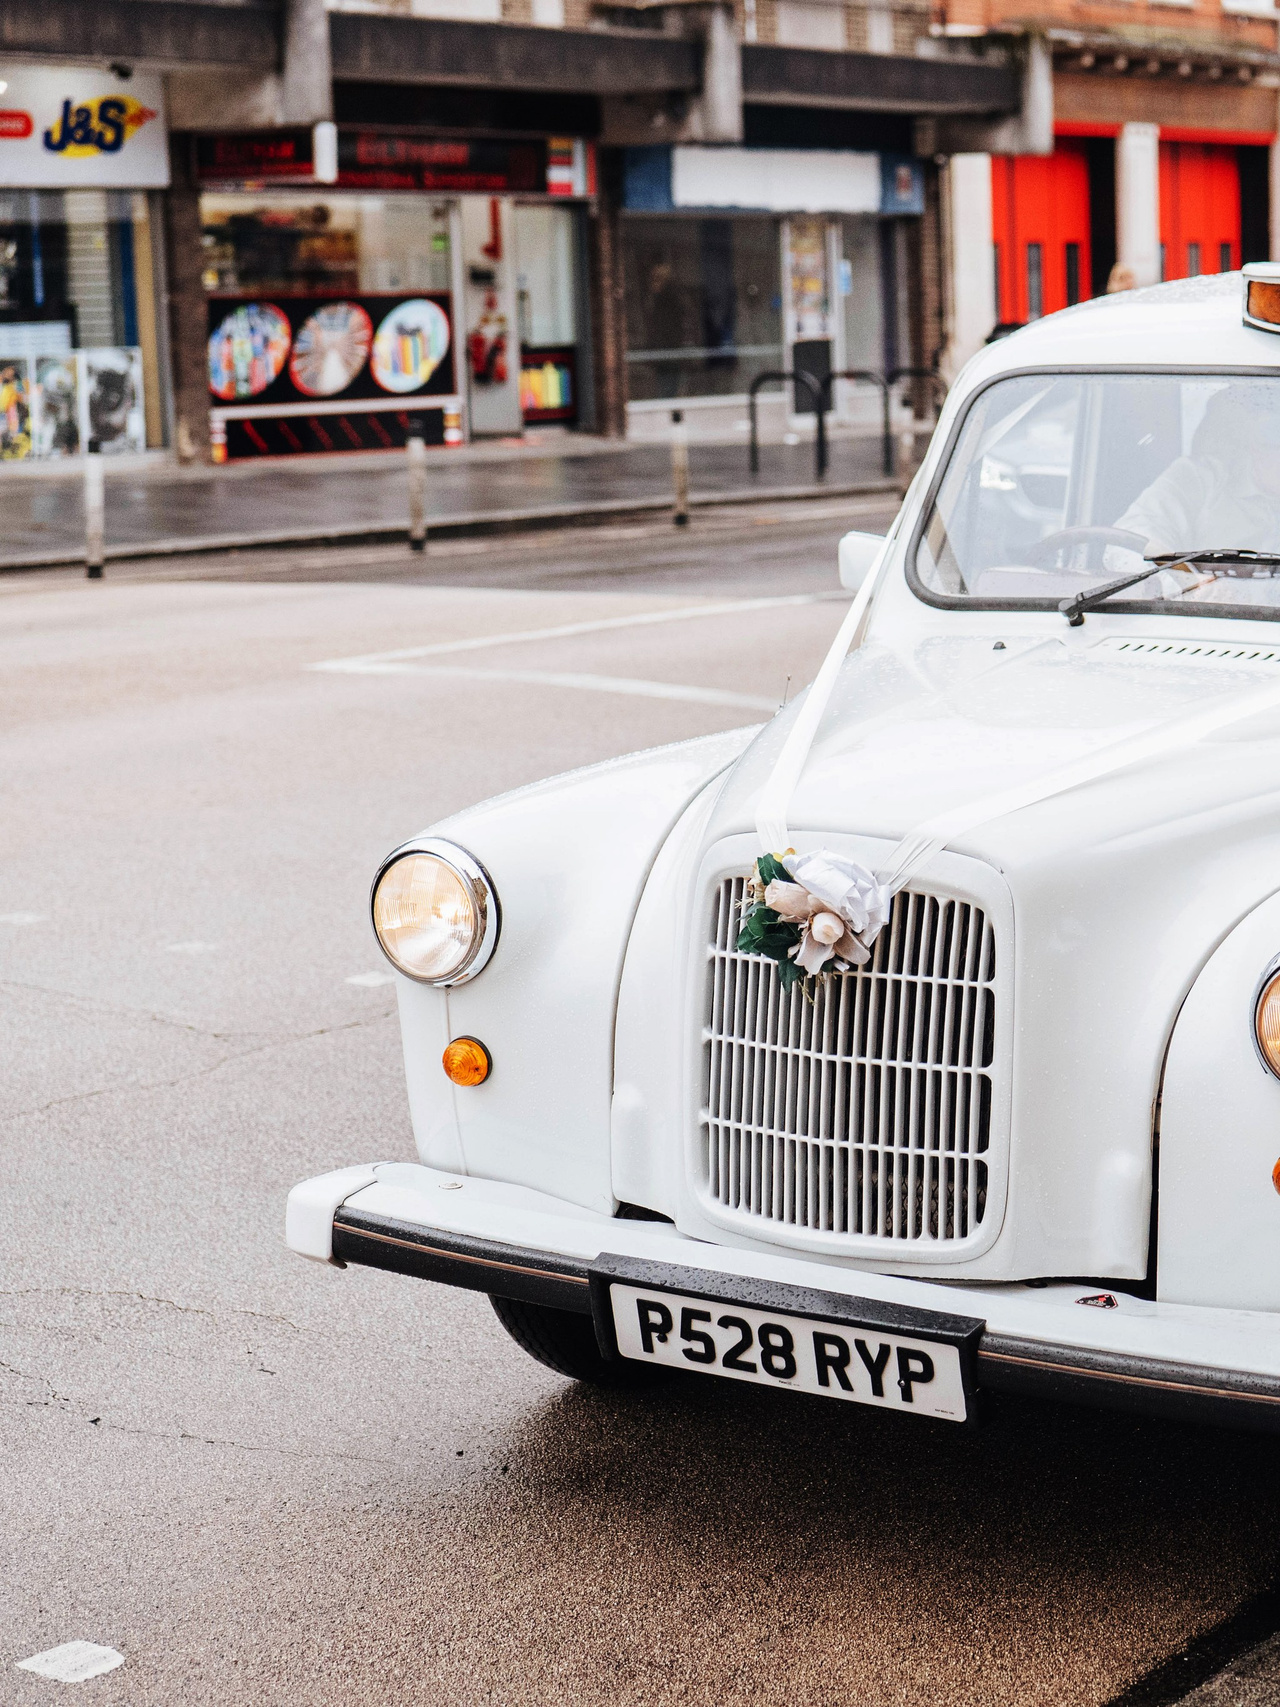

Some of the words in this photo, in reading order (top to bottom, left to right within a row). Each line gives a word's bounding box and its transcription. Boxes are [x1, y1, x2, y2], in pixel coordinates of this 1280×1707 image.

[43, 97, 126, 152] J&S
[636, 1298, 797, 1379] P528
[812, 1330, 935, 1403] RYP
